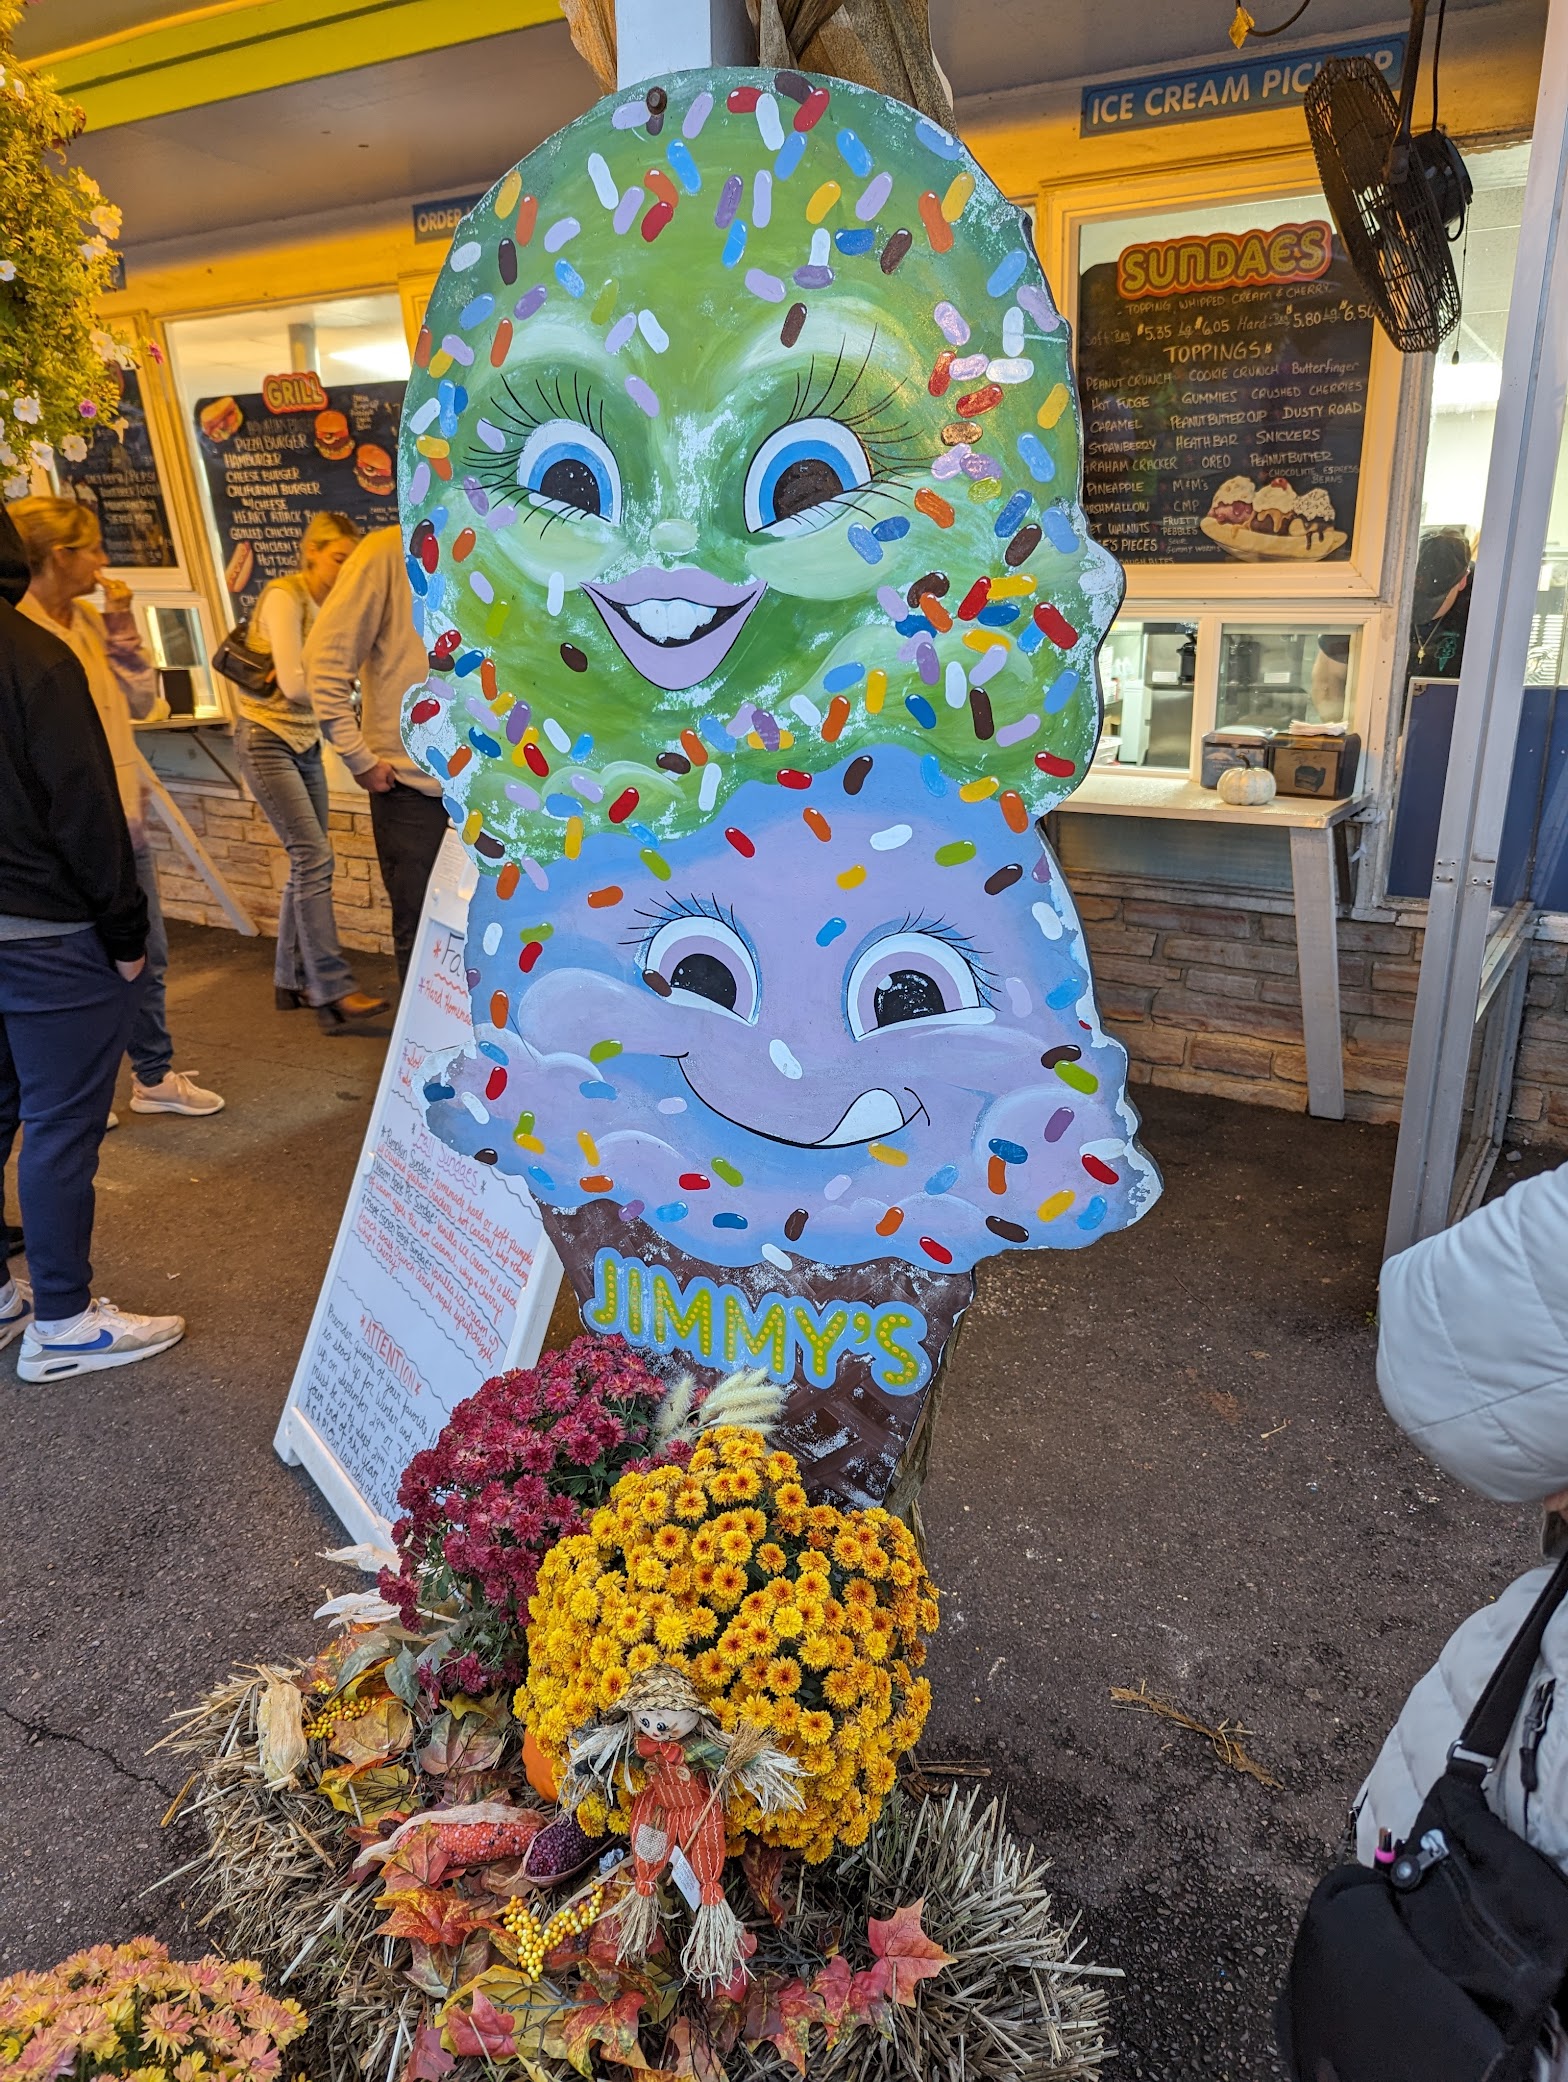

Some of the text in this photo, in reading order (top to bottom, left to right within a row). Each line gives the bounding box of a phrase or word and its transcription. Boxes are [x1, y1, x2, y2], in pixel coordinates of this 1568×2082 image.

[1092, 62, 1322, 124] ICE CREAM PIC
[417, 208, 462, 233] ORDER
[1124, 231, 1322, 290] SUNDAES
[1179, 295, 1225, 309] WHIPPED
[1232, 291, 1272, 304] CREAM
[1286, 283, 1330, 298] CHERRY
[1163, 341, 1261, 363] TOPPINGS
[1188, 364, 1279, 382] COOKIE CRUNCH
[1291, 358, 1360, 377] Butterfinger
[1086, 372, 1172, 391] PEANUT CRUNCH
[266, 377, 323, 408] GRILL
[1181, 390, 1238, 405] GUMMIES
[1251, 381, 1363, 400] CRUSHED CHERRIES
[1116, 395, 1151, 410] FUDGE
[1246, 410, 1268, 424] CUP
[1281, 402, 1362, 420] DUSTY ROAD
[1090, 419, 1143, 434] CARAMEL
[1256, 429, 1321, 445] SNICKERS
[1088, 439, 1156, 455] STRAWBERRY
[223, 451, 282, 468] HAMBURGER
[1132, 456, 1178, 472] CRACKER
[1201, 454, 1232, 470] OREO
[261, 466, 300, 482] BURGER
[280, 481, 321, 496] BURGER
[1086, 481, 1144, 496] PINEAPPLE
[1084, 501, 1150, 515] ARSHMALLOW
[1173, 500, 1200, 513] CMP
[1108, 522, 1150, 535] WALNUTS
[1162, 516, 1199, 526] FRUITY
[1161, 526, 1198, 536] PEBBLES
[1121, 538, 1158, 551] PIECES
[439, 1147, 478, 1188] Sundaes
[483, 1218, 493, 1229] or
[507, 1239, 534, 1266] pumpki
[593, 1257, 920, 1387] JIMMY'S
[363, 1318, 417, 1391] ATTENTION
